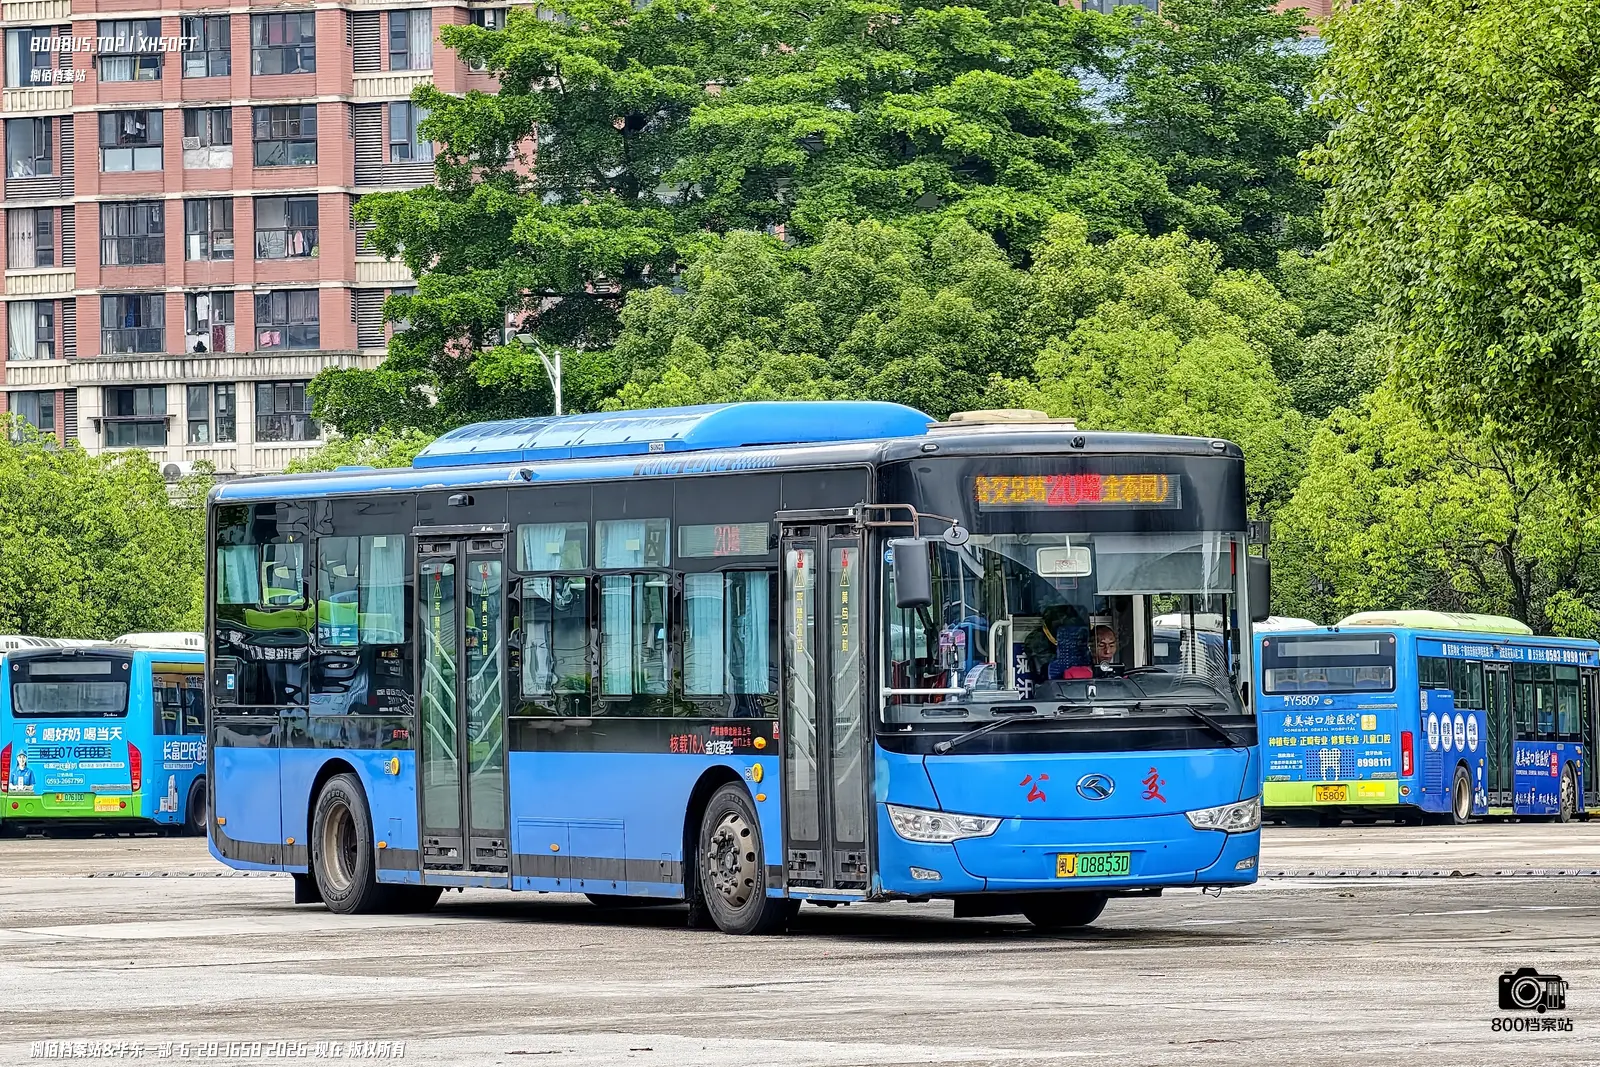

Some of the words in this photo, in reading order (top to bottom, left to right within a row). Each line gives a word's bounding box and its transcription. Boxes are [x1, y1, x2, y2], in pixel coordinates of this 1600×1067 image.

[43, 728, 80, 740] 喝好奶
[84, 727, 122, 740] 喝当天
[670, 734, 705, 753] 核载76人
[705, 741, 733, 754] 金龙客车
[1357, 758, 1391, 767] 8998111
[1019, 774, 1049, 803] 公
[1141, 767, 1167, 803] 交
[1318, 792, 1345, 801] Y5809
